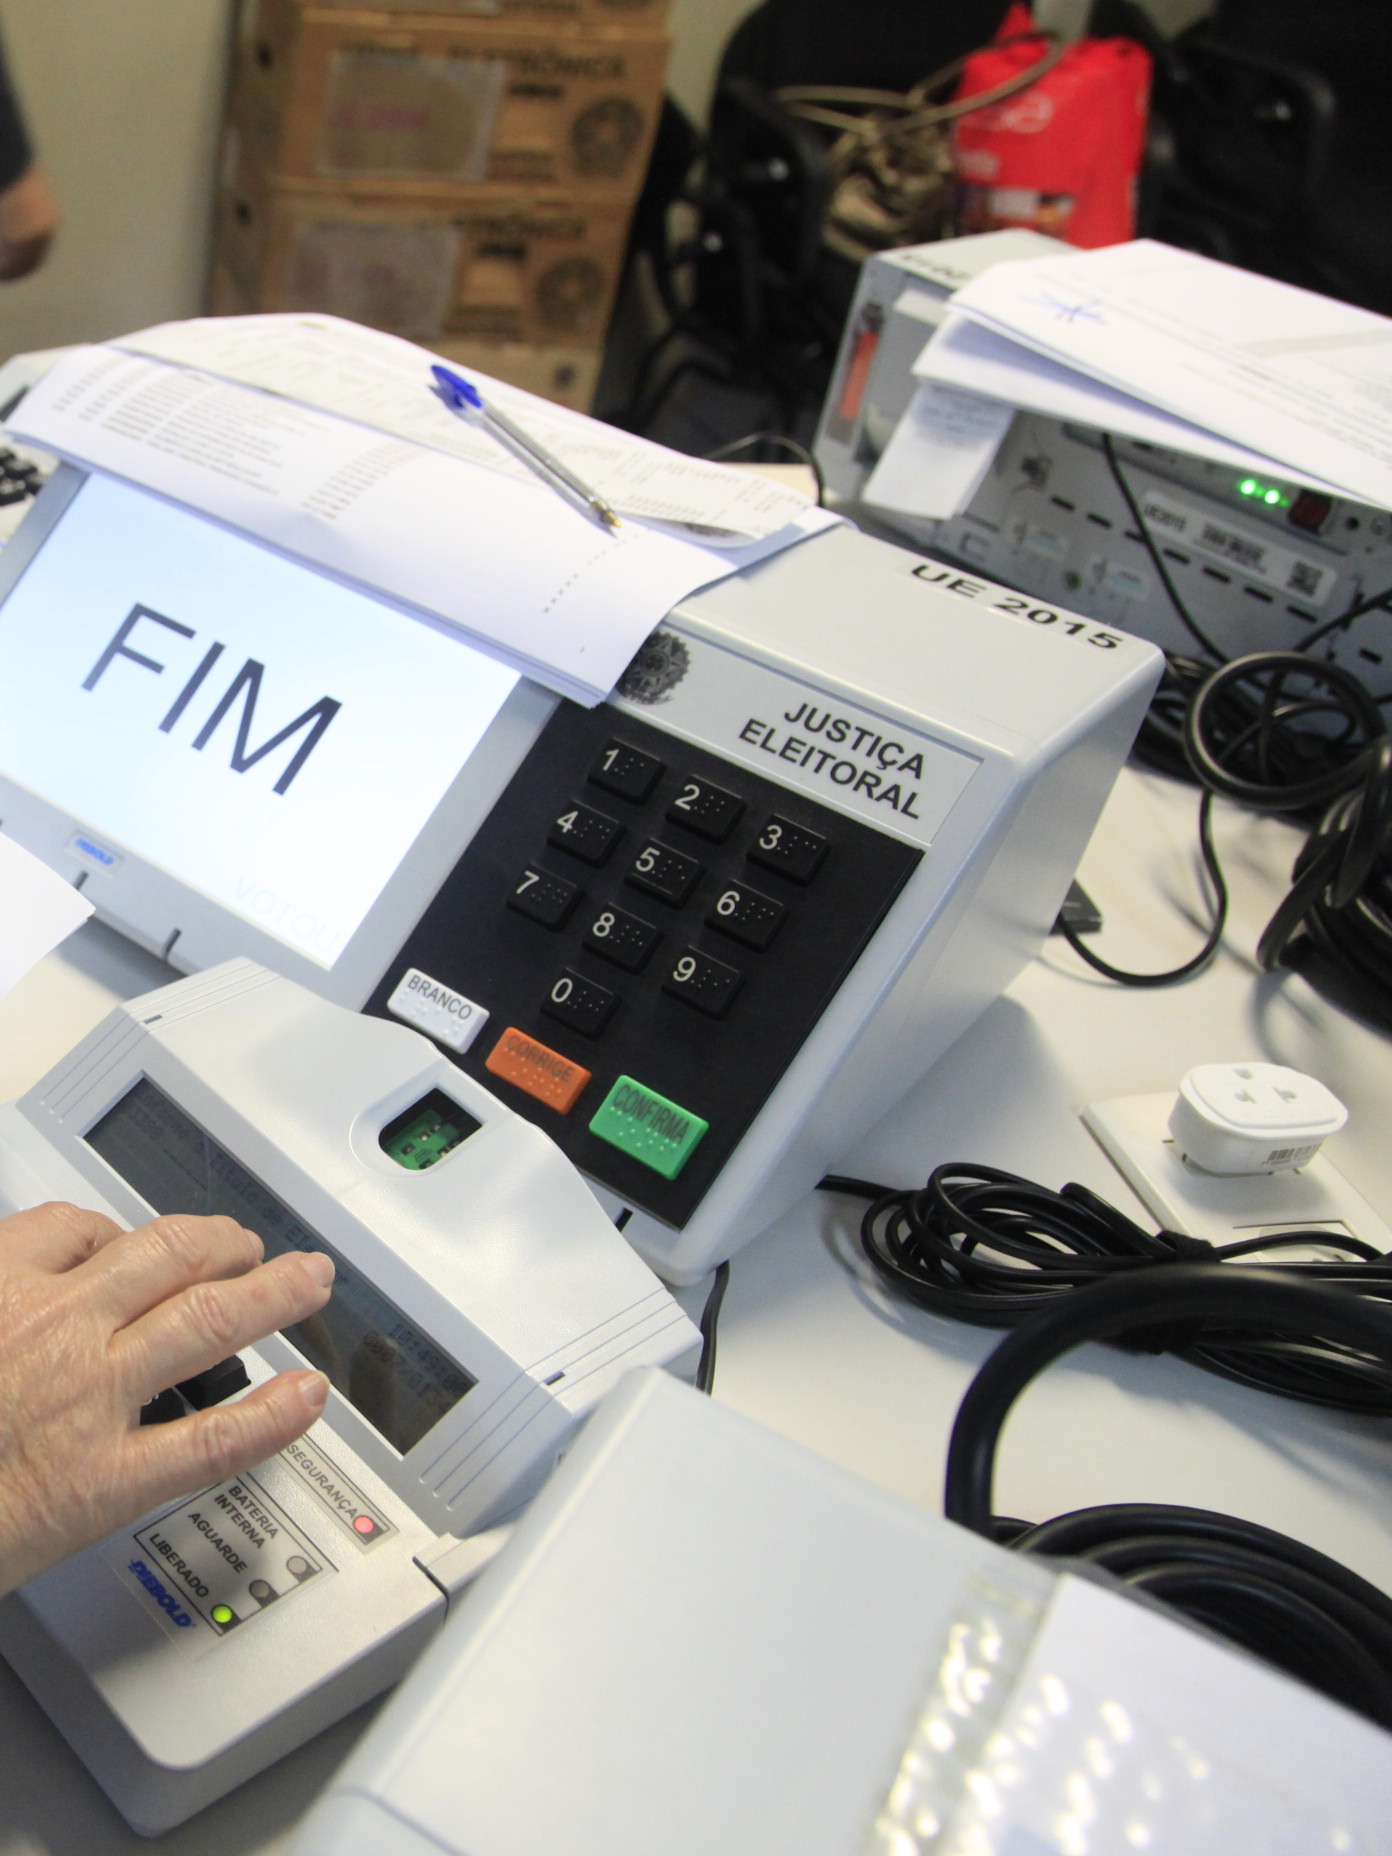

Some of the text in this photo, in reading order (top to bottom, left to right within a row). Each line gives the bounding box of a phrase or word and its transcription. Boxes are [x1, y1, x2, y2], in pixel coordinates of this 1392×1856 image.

[911, 564, 1123, 650] UE 2015
[82, 603, 343, 796] FIM
[603, 749, 619, 771] 1
[784, 702, 924, 780] JUSTIÇA
[738, 718, 921, 820] ELEITORAL
[557, 810, 579, 833] 4
[674, 784, 700, 811] 2
[635, 847, 660, 872] 5
[759, 824, 783, 850] 3
[516, 870, 540, 894] 7
[716, 890, 740, 915] 6
[592, 912, 615, 937] 8
[551, 978, 573, 1003] 0
[673, 956, 696, 982] 9
[408, 974, 472, 1020] BRANCO
[507, 1034, 576, 1083] CORRIGE
[612, 1084, 691, 1146] CONFIRMA
[286, 1443, 358, 1520] SEGURANÇA
[214, 1494, 265, 1549] INTERNA
[228, 1485, 279, 1539] BATERIA
[149, 1533, 210, 1598] LIBERADO
[188, 1512, 248, 1574] AGUARDE
[128, 1559, 193, 1628] DIEBOLD
